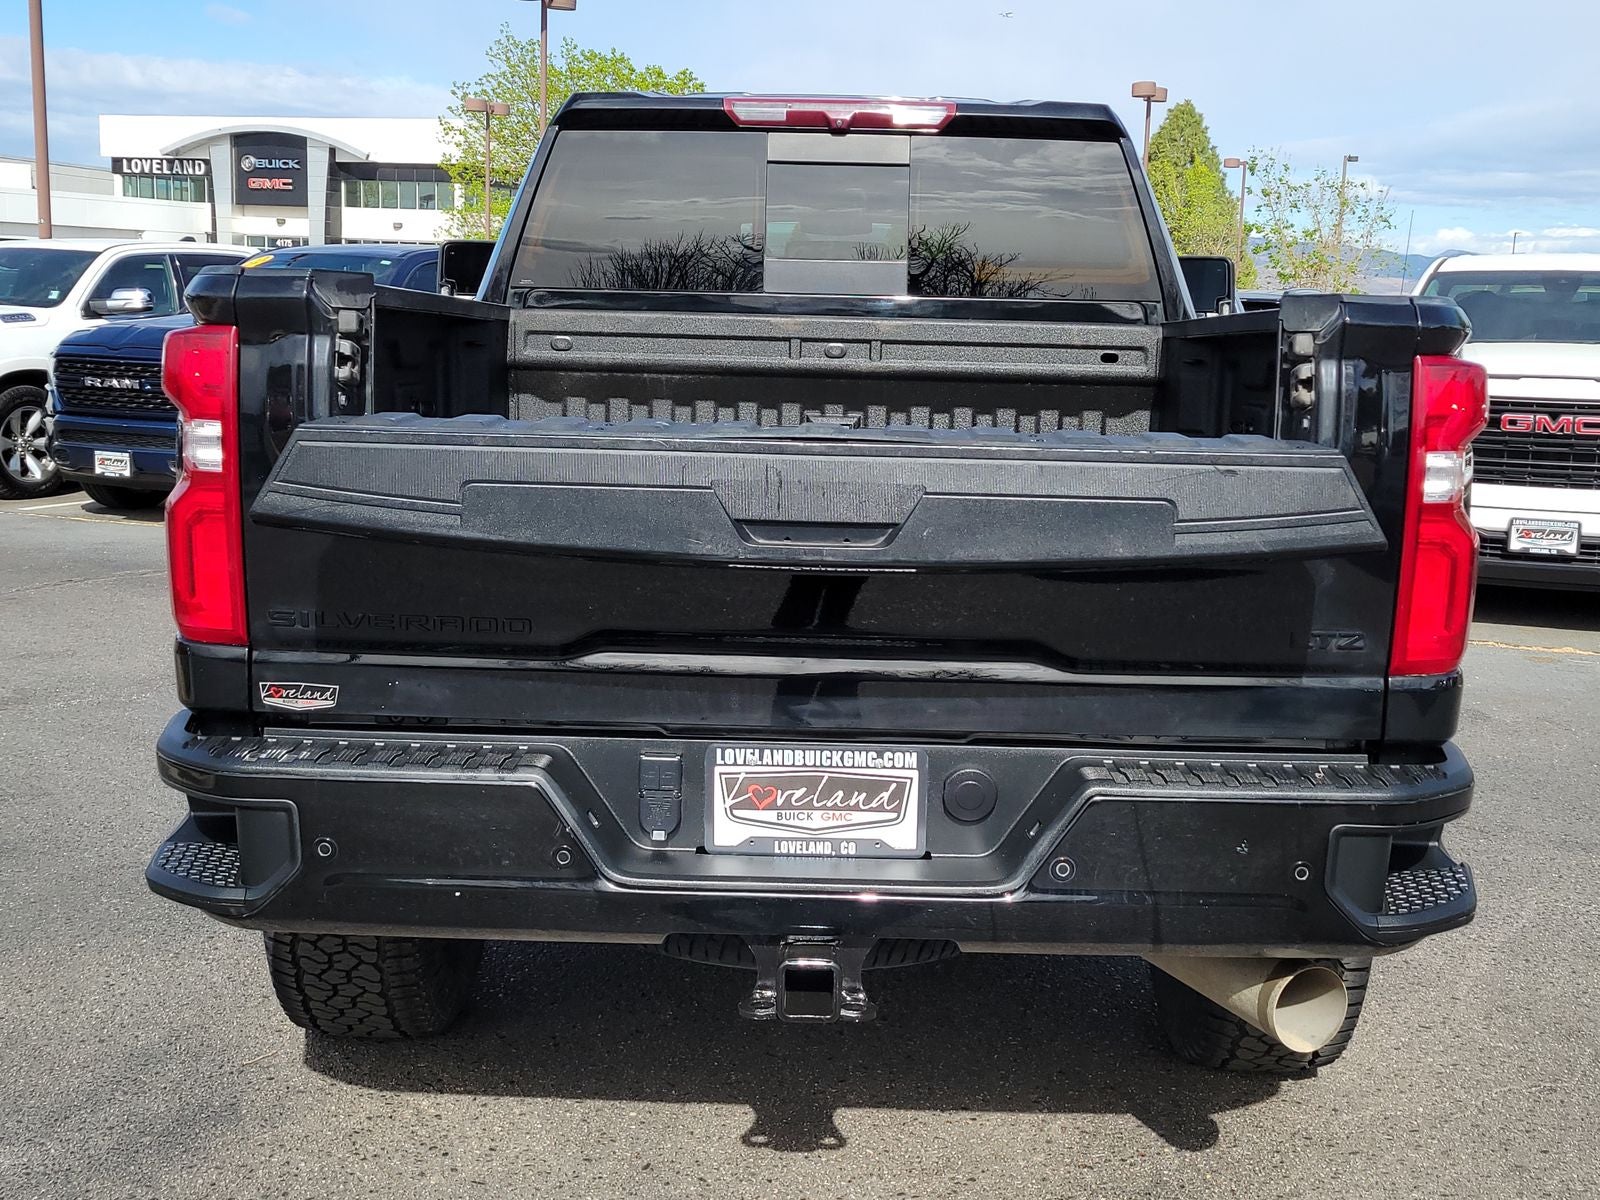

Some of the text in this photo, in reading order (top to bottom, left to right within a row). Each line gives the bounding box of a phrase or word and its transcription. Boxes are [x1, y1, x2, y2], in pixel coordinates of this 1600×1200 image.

[122, 158, 205, 175] LOVELAND
[255, 159, 301, 169] BUICK
[248, 178, 293, 190] GMC
[276, 239, 292, 247] 4175
[84, 376, 140, 389] RAM
[1500, 413, 1600, 435] GMC
[267, 609, 533, 635] SILVERADO
[263, 683, 335, 700] Loveland
[716, 748, 917, 768] LOVELANDBUICKGMC.COM
[724, 772, 900, 811] Loveland
[776, 811, 853, 822] BUICK GMC
[774, 840, 857, 856] LOVELAND, CO
